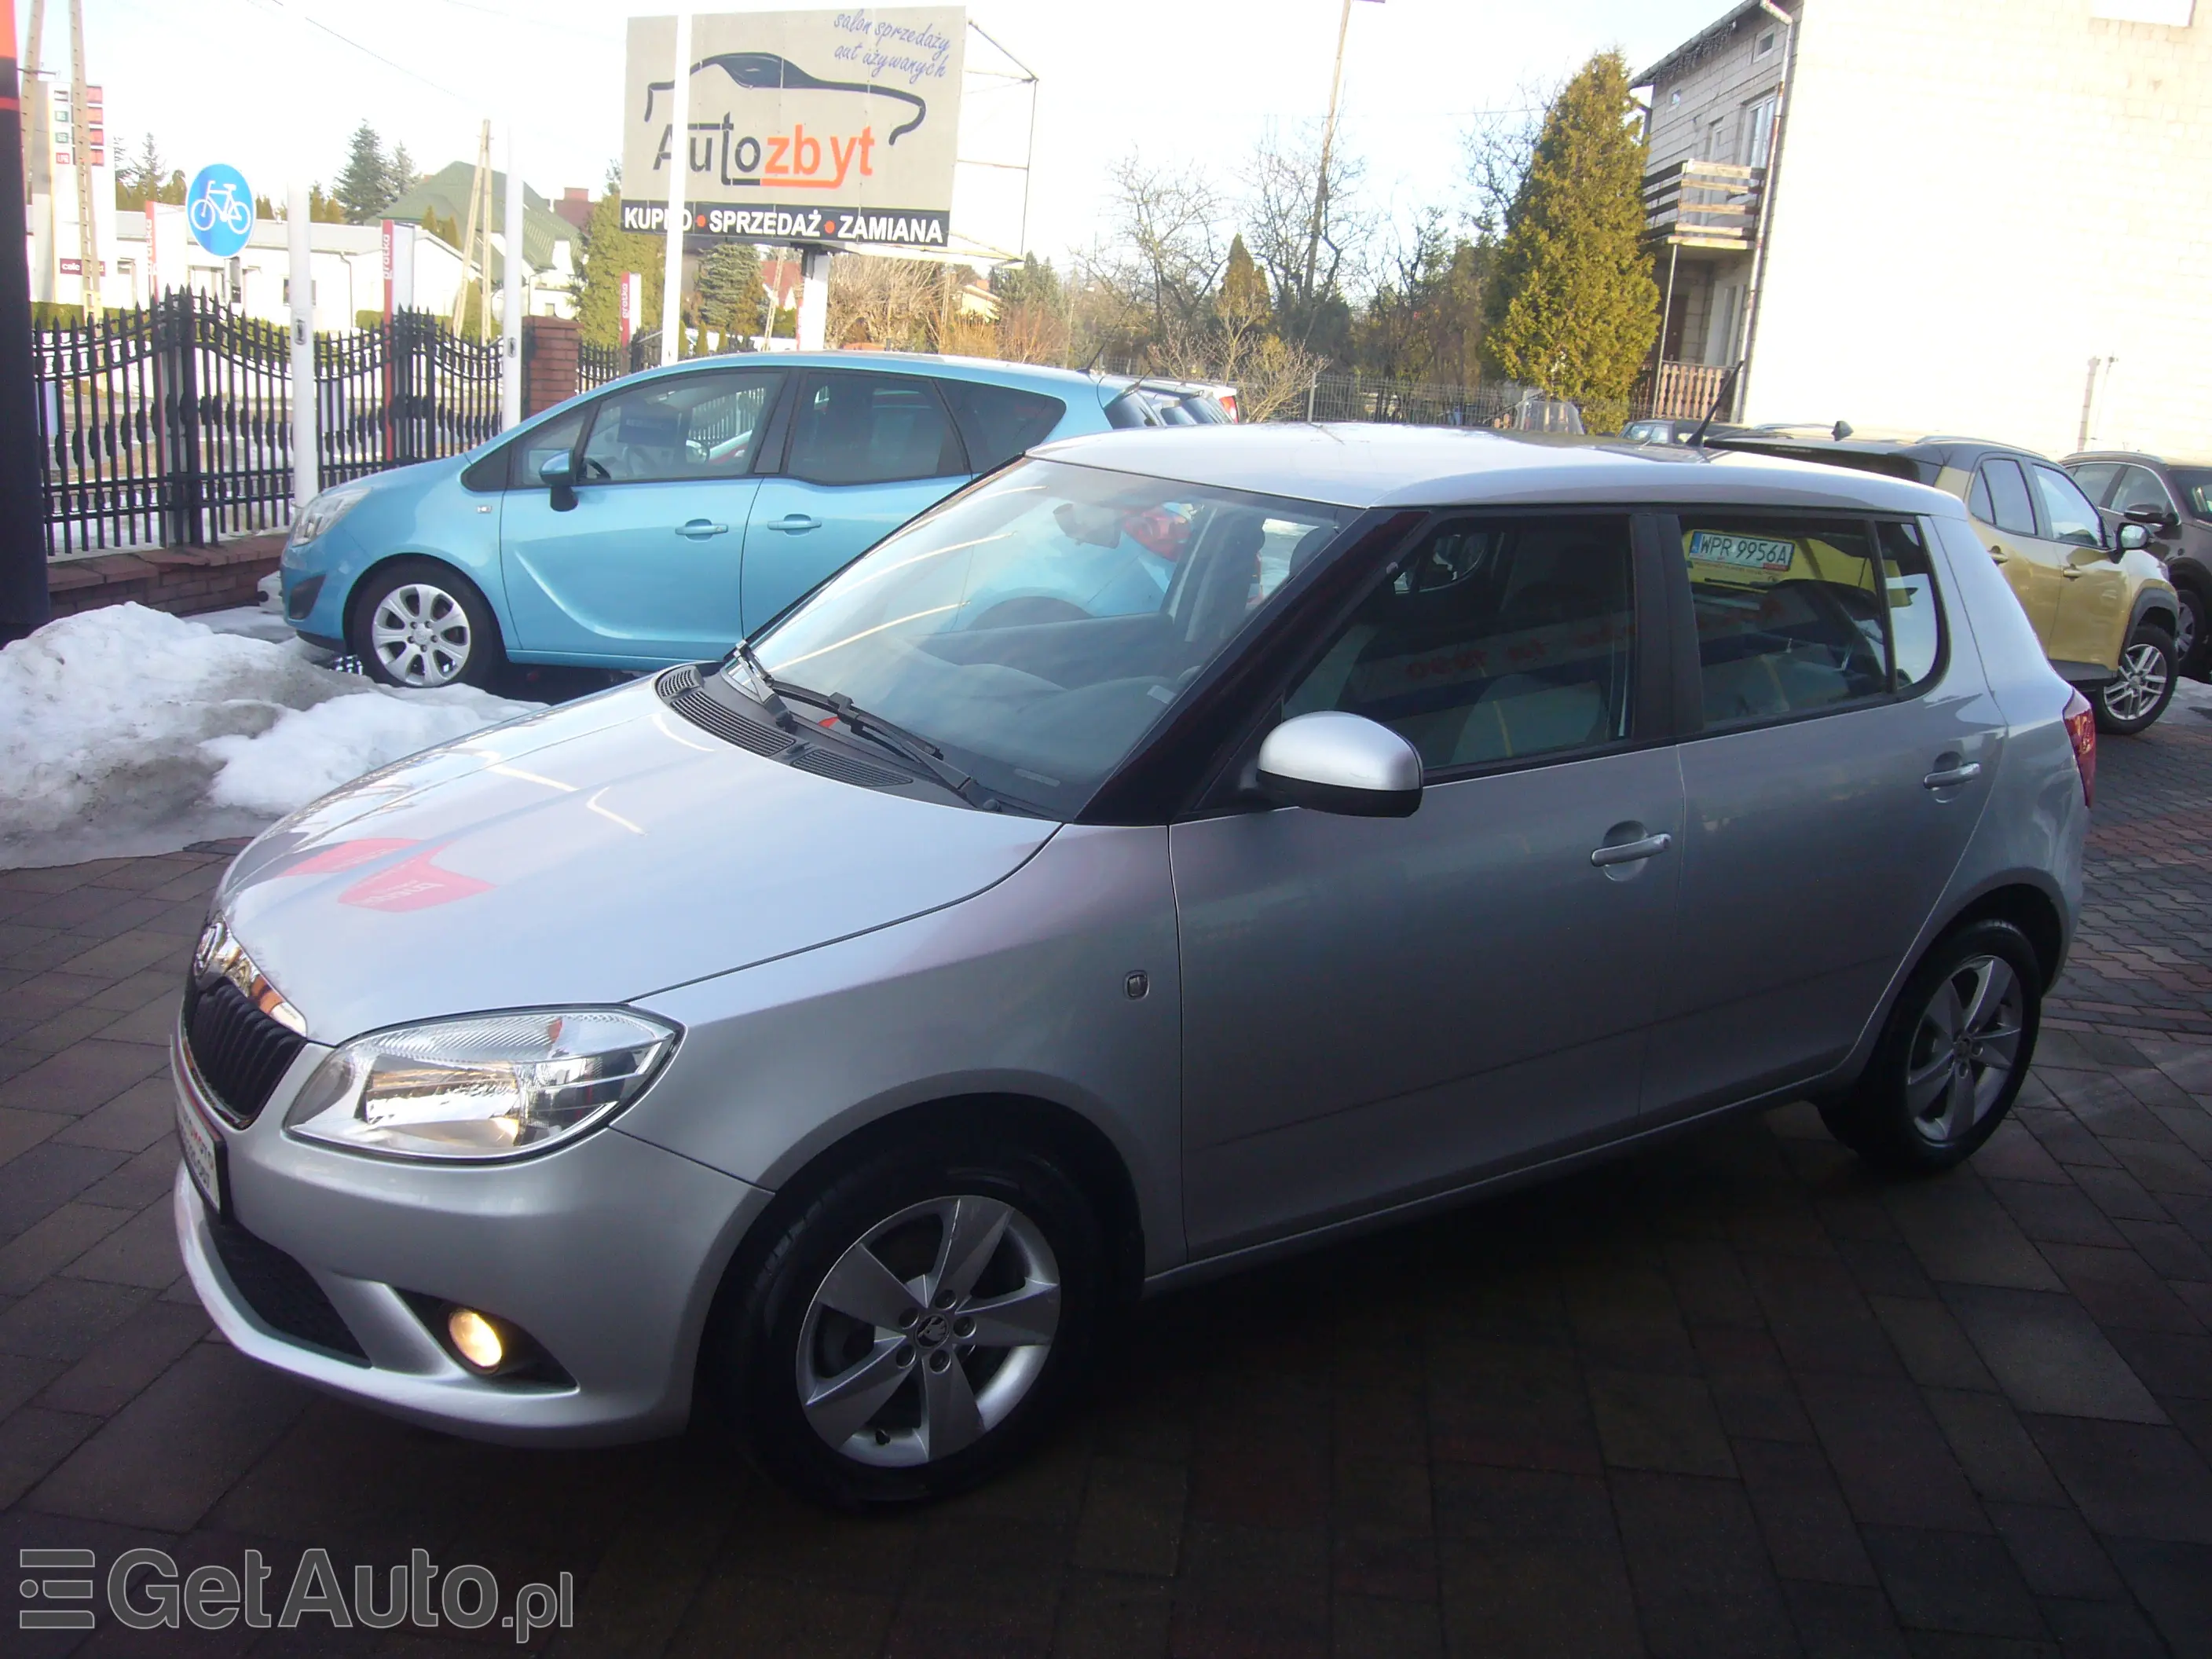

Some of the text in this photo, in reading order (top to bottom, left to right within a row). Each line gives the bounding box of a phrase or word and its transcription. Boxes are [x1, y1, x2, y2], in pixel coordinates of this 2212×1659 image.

[833, 8, 950, 61] salon sprzedaży
[833, 42, 950, 84] aut używanych
[709, 209, 822, 237] SPRZEDAŻ
[837, 215, 943, 243] ZAMIANA
[383, 234, 393, 280] gratka
[1700, 535, 1787, 564] WPR 9956A
